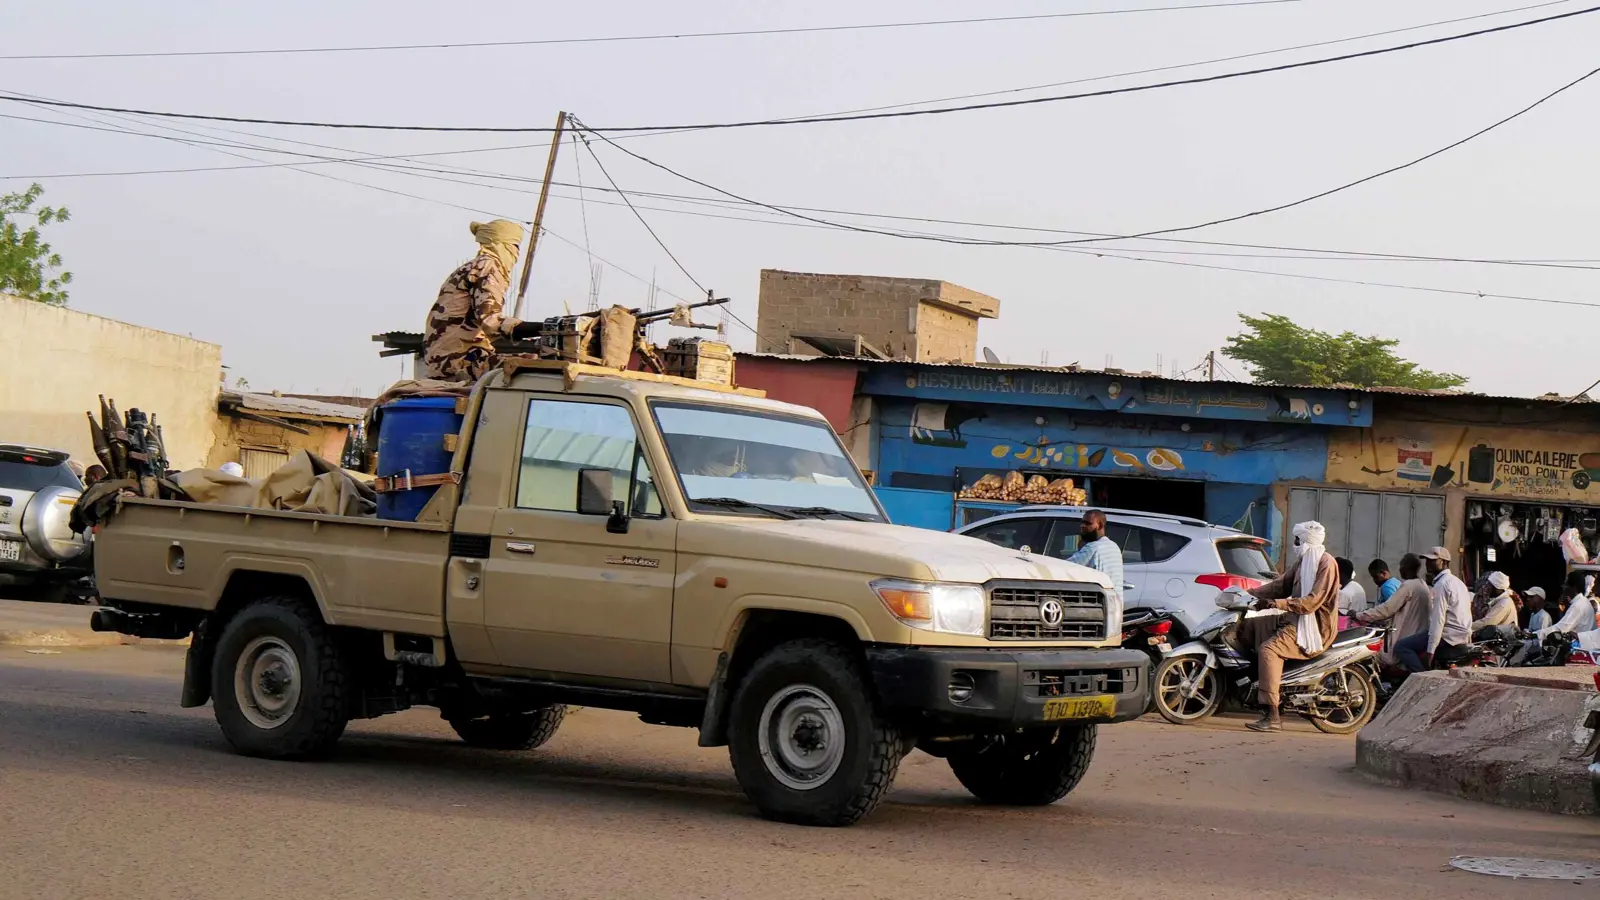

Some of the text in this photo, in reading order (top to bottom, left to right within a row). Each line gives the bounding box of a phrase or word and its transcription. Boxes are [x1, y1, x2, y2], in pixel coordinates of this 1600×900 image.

[916, 372, 1025, 394] RESTAURANT
[1503, 464, 1569, 480] ROND POINT
